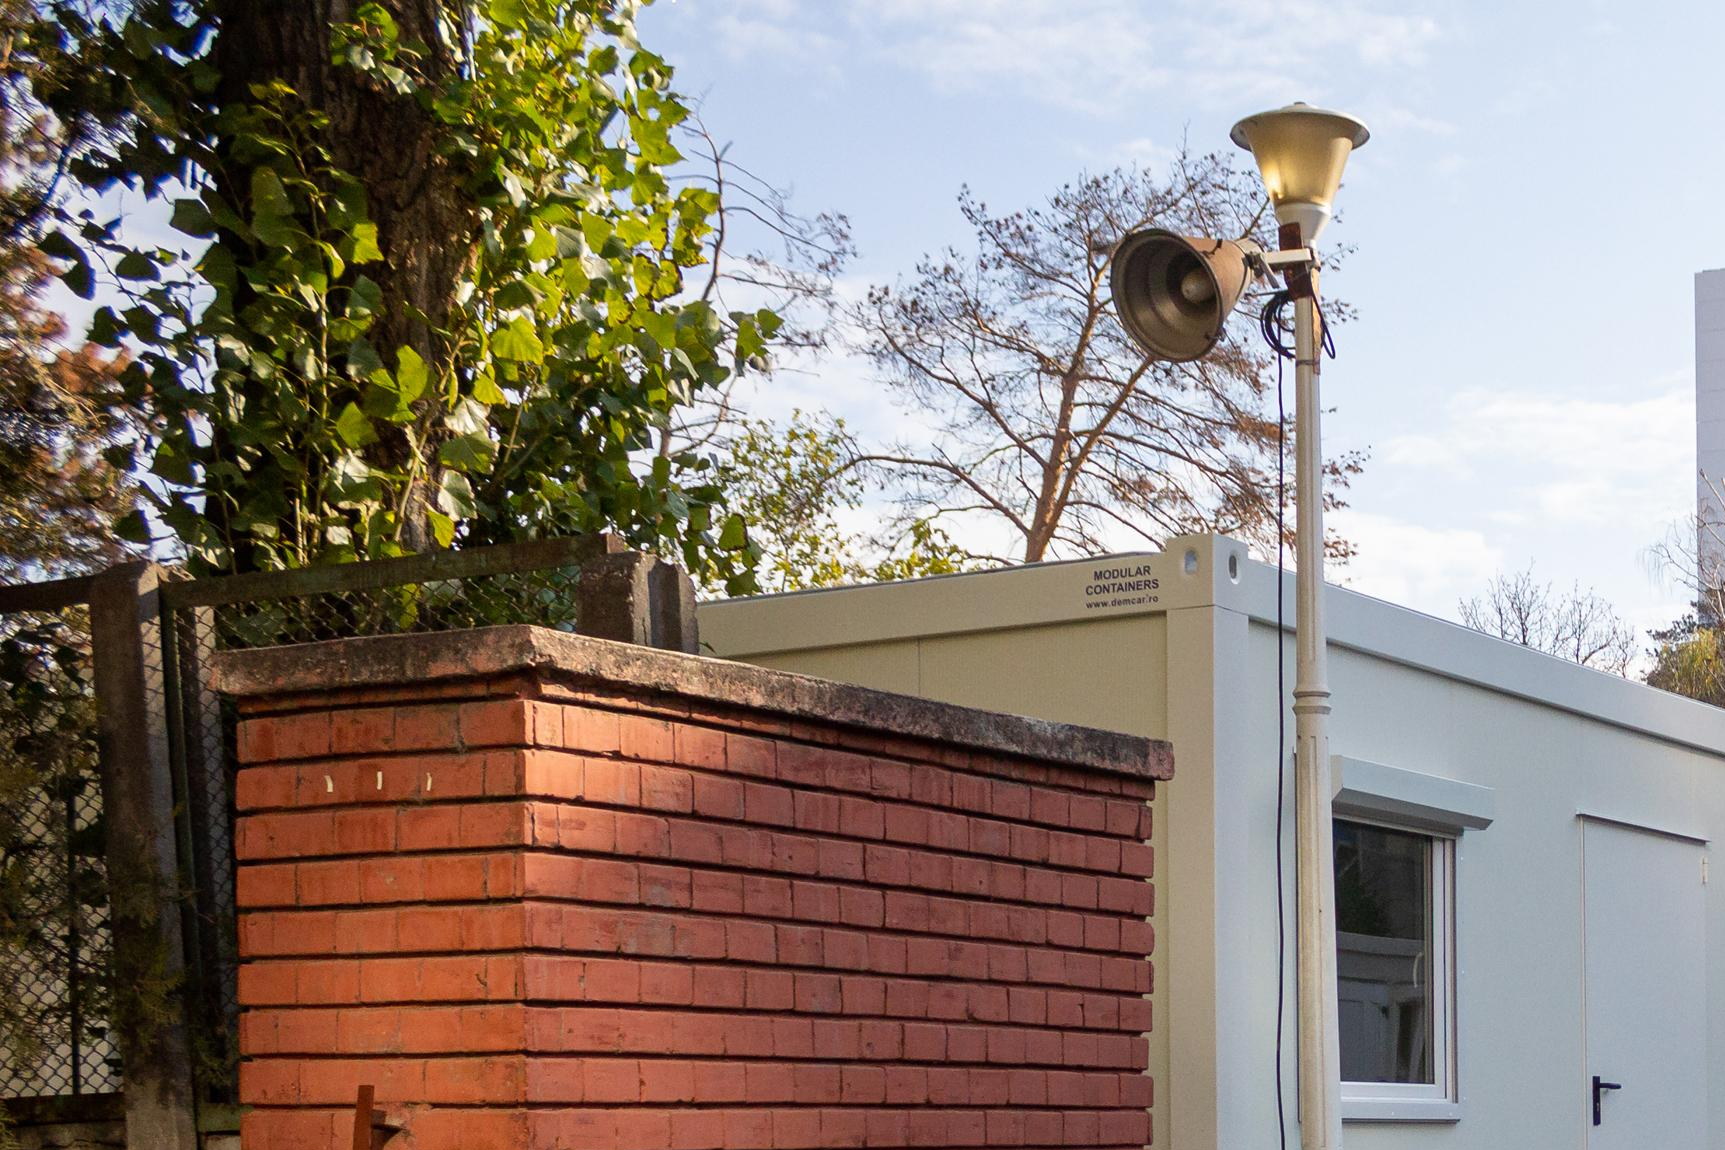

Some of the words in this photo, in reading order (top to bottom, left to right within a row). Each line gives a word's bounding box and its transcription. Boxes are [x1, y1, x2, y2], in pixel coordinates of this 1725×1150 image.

[1093, 565, 1151, 581] MODULAR
[1085, 579, 1160, 596] CONTAINERS
[1086, 595, 1159, 609] www.demcar.ro
